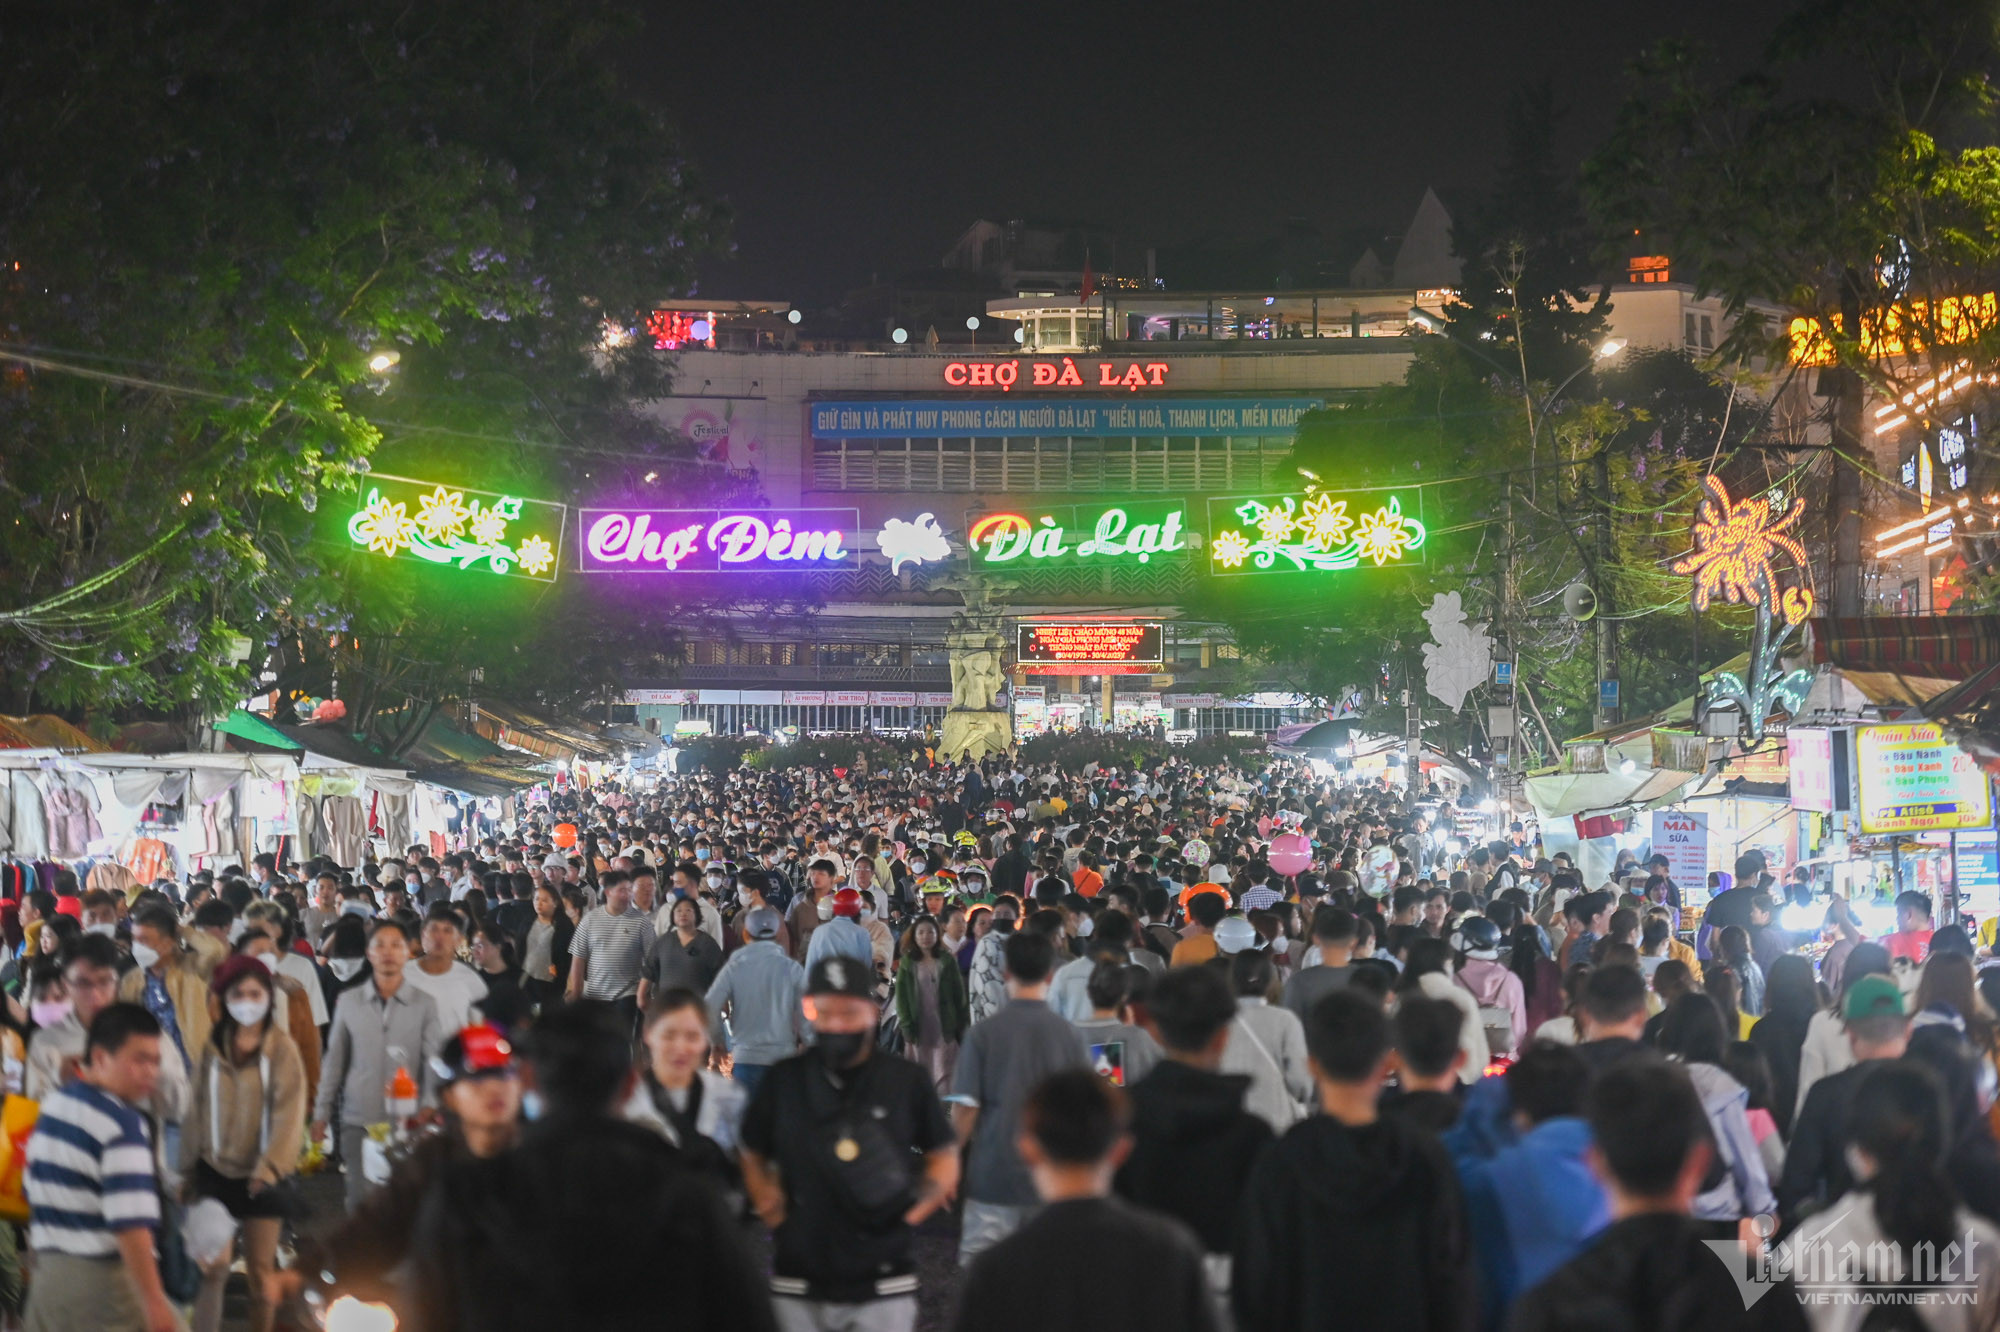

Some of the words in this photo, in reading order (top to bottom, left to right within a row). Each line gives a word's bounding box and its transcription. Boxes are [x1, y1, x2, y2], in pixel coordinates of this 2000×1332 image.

[944, 359, 1019, 392] CHỢ
[1033, 356, 1083, 386] ĐÀ
[1099, 362, 1169, 391] LẠT
[818, 407, 838, 430] GIỮ
[841, 407, 861, 430] GÌN
[864, 407, 879, 430] VÀ
[883, 407, 912, 430] PHÁT
[915, 409, 938, 430] HUY
[941, 409, 981, 429] PHONG
[985, 406, 1016, 429] CÁCH
[1019, 405, 1056, 429] NGƯỜI
[1058, 405, 1075, 428] ĐÀ
[1076, 408, 1097, 432] LẠT
[1139, 406, 1166, 430] HOÀ,
[1168, 409, 1206, 428] THANH
[1209, 409, 1238, 432] LỊCH,
[1242, 403, 1268, 427] MẾN
[587, 513, 704, 570] Chợ
[707, 515, 848, 562] Đêm
[969, 514, 1069, 562] Đà
[1077, 508, 1185, 563] Lạt
[1917, 761, 1943, 773] Xanh
[1664, 821, 1696, 831] MAI
[1669, 833, 1689, 842] SỮA
